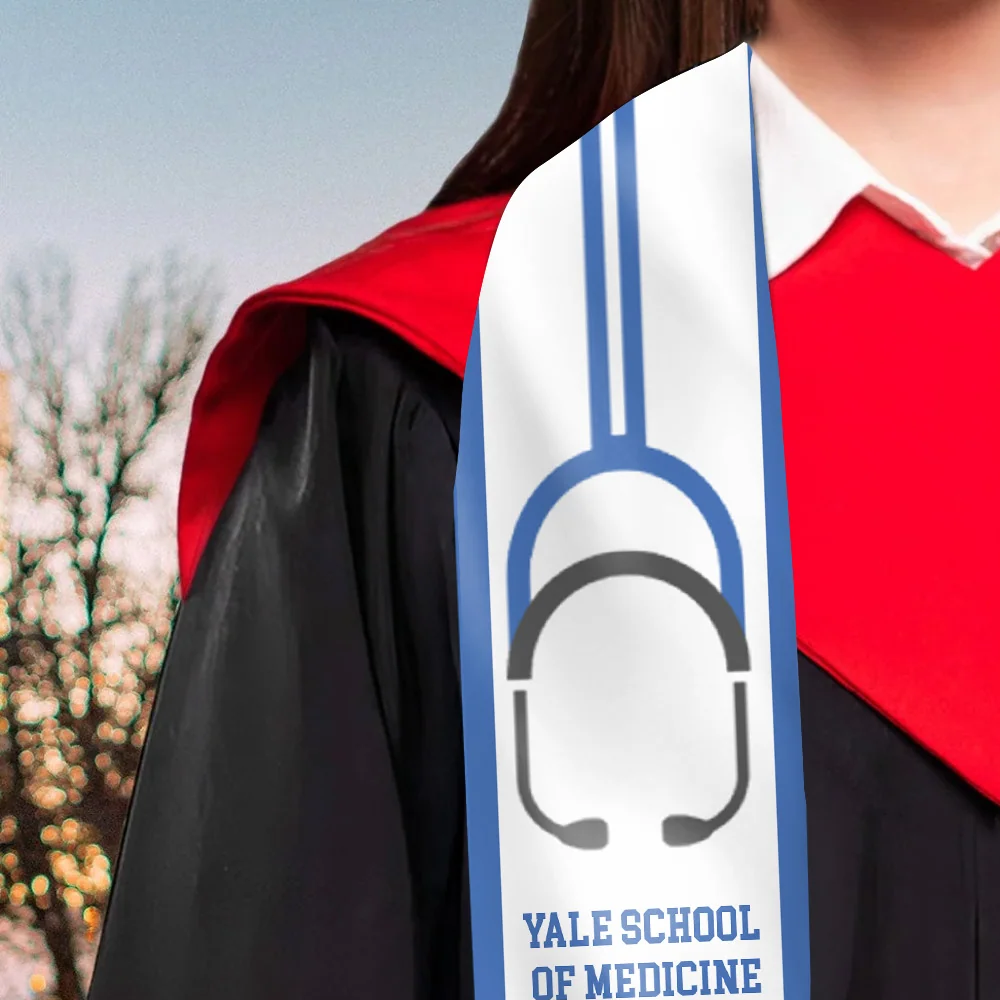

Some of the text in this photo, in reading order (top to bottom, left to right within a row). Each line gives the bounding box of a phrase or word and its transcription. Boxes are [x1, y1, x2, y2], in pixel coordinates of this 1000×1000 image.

[522, 904, 761, 949] YALE SCHOOL
[584, 957, 762, 1000] MEDICINE
